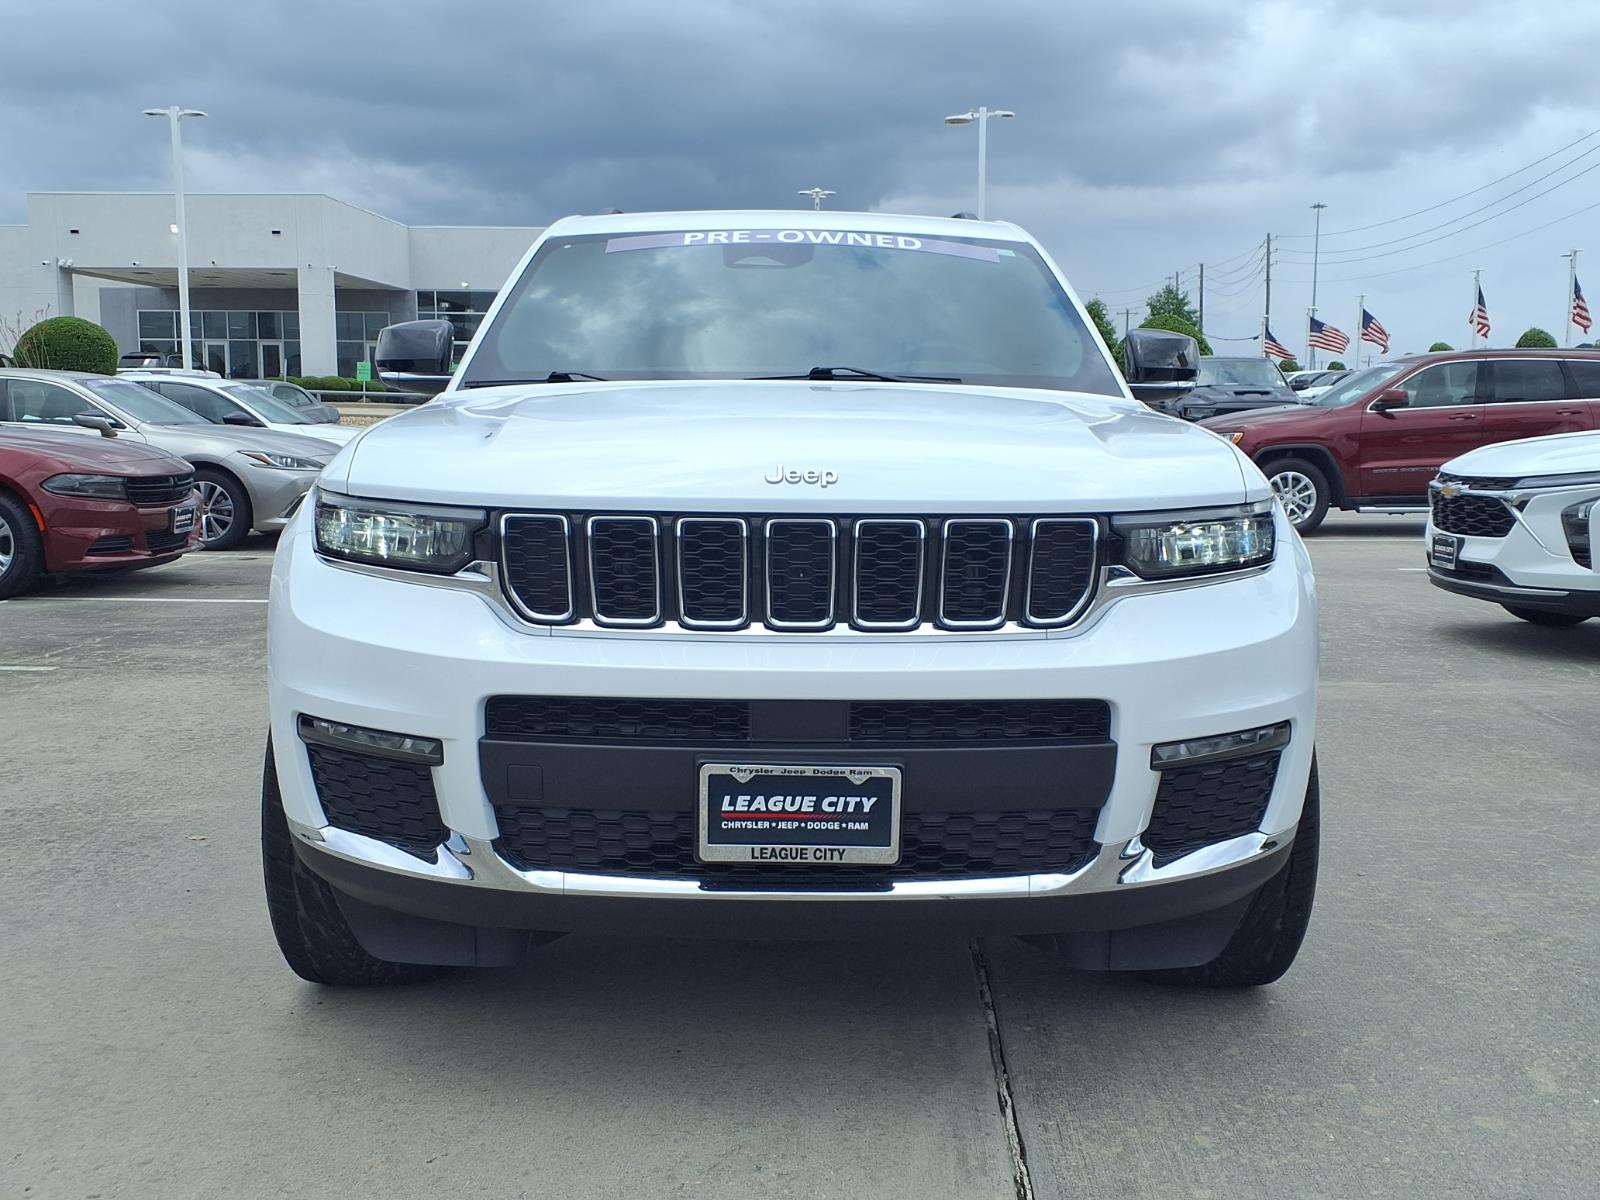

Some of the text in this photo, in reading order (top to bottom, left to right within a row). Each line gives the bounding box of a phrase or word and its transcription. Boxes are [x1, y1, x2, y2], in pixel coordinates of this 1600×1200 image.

[683, 230, 922, 250] PRE-OWNED
[765, 466, 838, 488] Jeep
[730, 767, 774, 776] Chrysler
[780, 768, 807, 776] Jeep
[721, 795, 878, 813] LEAGUE CITY
[721, 821, 869, 831] CHRYSLER JEEP DODGE RAM
[751, 848, 846, 861] LEAGUE CITY
